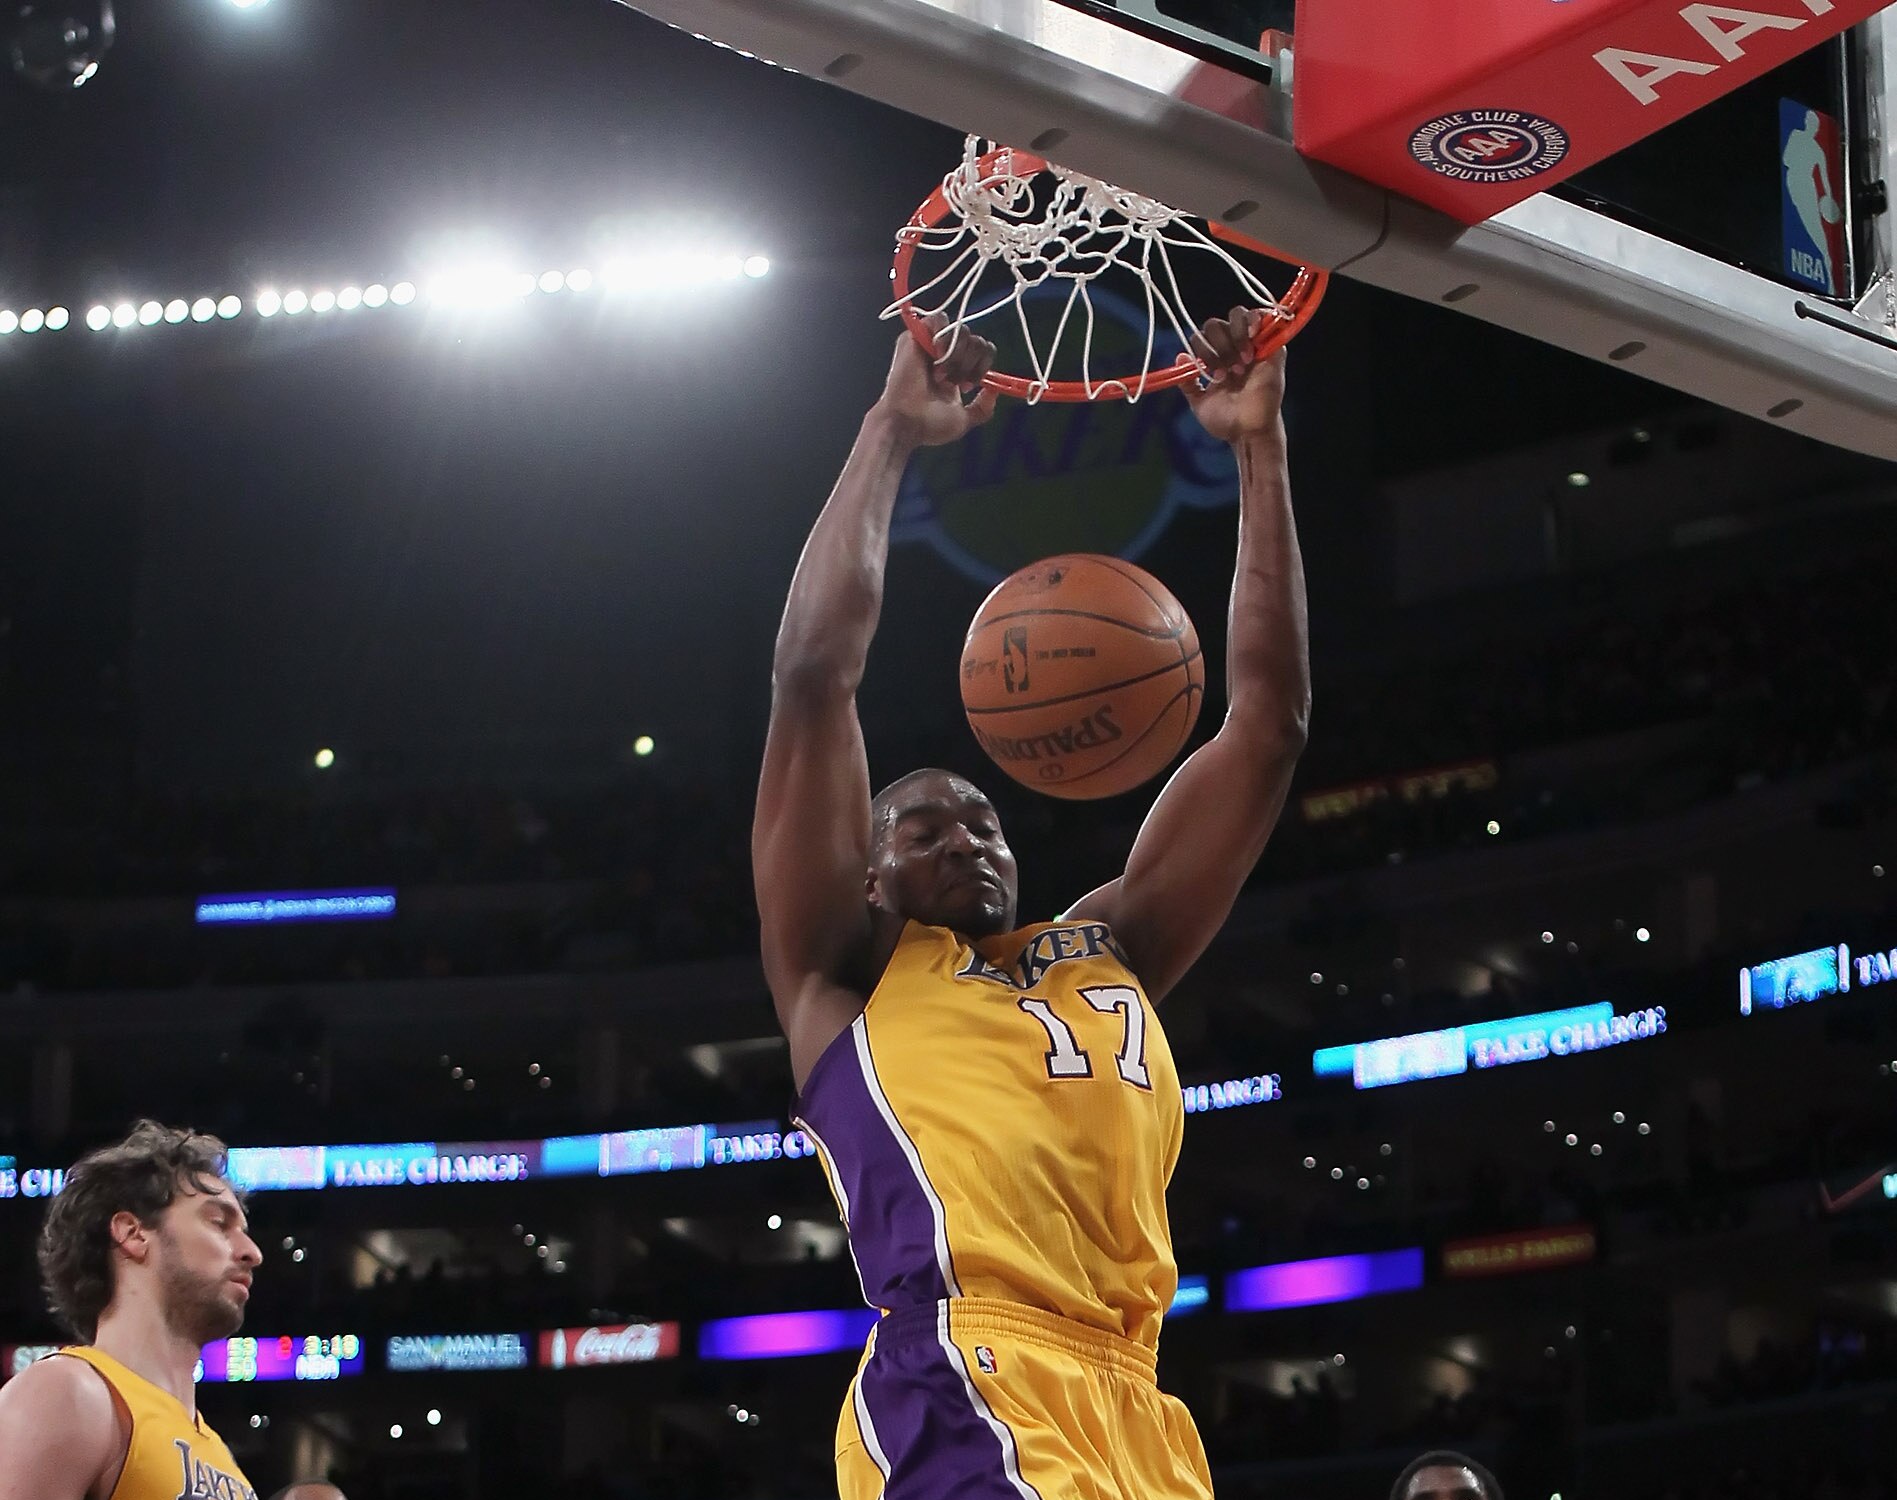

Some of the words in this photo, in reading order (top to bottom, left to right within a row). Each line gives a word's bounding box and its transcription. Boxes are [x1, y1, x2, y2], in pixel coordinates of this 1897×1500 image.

[1412, 114, 1467, 162] AUTOMOBILE
[1471, 111, 1520, 124] CLUB
[1435, 162, 1536, 182] SOUTHERN
[1528, 118, 1566, 169] CALIFORNIA
[1454, 130, 1519, 161] AAA
[1791, 248, 1825, 284] NBA
[1016, 984, 1152, 1090] 17
[1470, 1029, 1549, 1069] TAKE
[1551, 1006, 1667, 1056] CHARGE
[1181, 1073, 1282, 1113] HARGE
[710, 1132, 782, 1165] TAKE
[334, 1158, 406, 1187] TAKE
[408, 1154, 528, 1186] CHARGE
